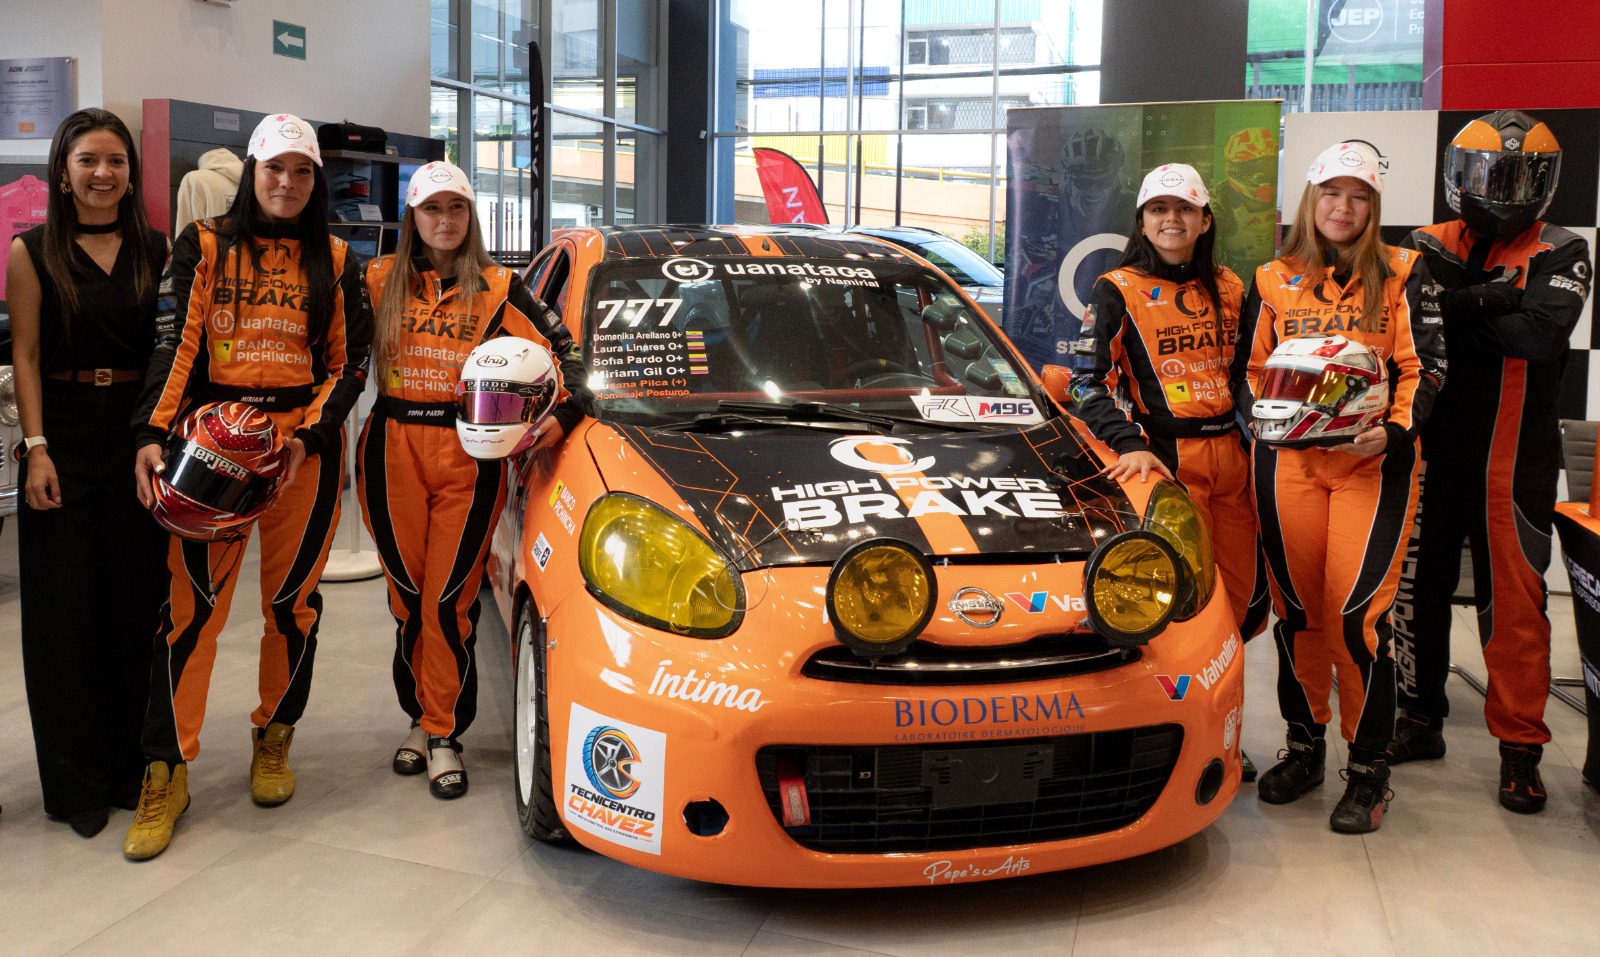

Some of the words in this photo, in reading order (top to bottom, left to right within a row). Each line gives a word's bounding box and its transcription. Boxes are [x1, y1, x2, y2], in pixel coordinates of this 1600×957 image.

[1331, 7, 1380, 26] JEP
[724, 262, 877, 280] uanataca
[805, 276, 817, 286] by
[826, 277, 881, 288] Namirial
[597, 298, 683, 329] 777
[593, 332, 635, 342] Domenika
[635, 331, 671, 340] Arellano
[236, 340, 286, 351] BANCO
[593, 345, 623, 354] Laura
[626, 344, 666, 352] Linares
[236, 351, 308, 365] PICHINCHA
[592, 357, 624, 366] Sofia
[627, 355, 663, 364] Pardo
[402, 367, 448, 381] BANCO
[592, 369, 640, 379] Miriam
[643, 367, 663, 376] Gil
[640, 379, 669, 387] Pilca
[595, 391, 644, 401] Homenaje
[646, 389, 690, 397] Postumo
[425, 409, 445, 417] PARDO
[978, 402, 1034, 417] M96
[770, 479, 883, 501] HIGH
[886, 476, 1051, 492] POWER
[560, 486, 576, 511] BANCO
[553, 500, 576, 537] PICHINCHA
[782, 490, 1064, 531] BRAKE
[1196, 632, 1239, 691] Valvoline
[895, 692, 1086, 727] BIODERMA
[895, 731, 976, 742] LABORATOIRE
[981, 724, 1086, 739] DERMATOLOGIQUE
[571, 783, 656, 821] TECNICENTRO
[923, 860, 981, 885] Pepe's
[982, 855, 1031, 876] Arts
